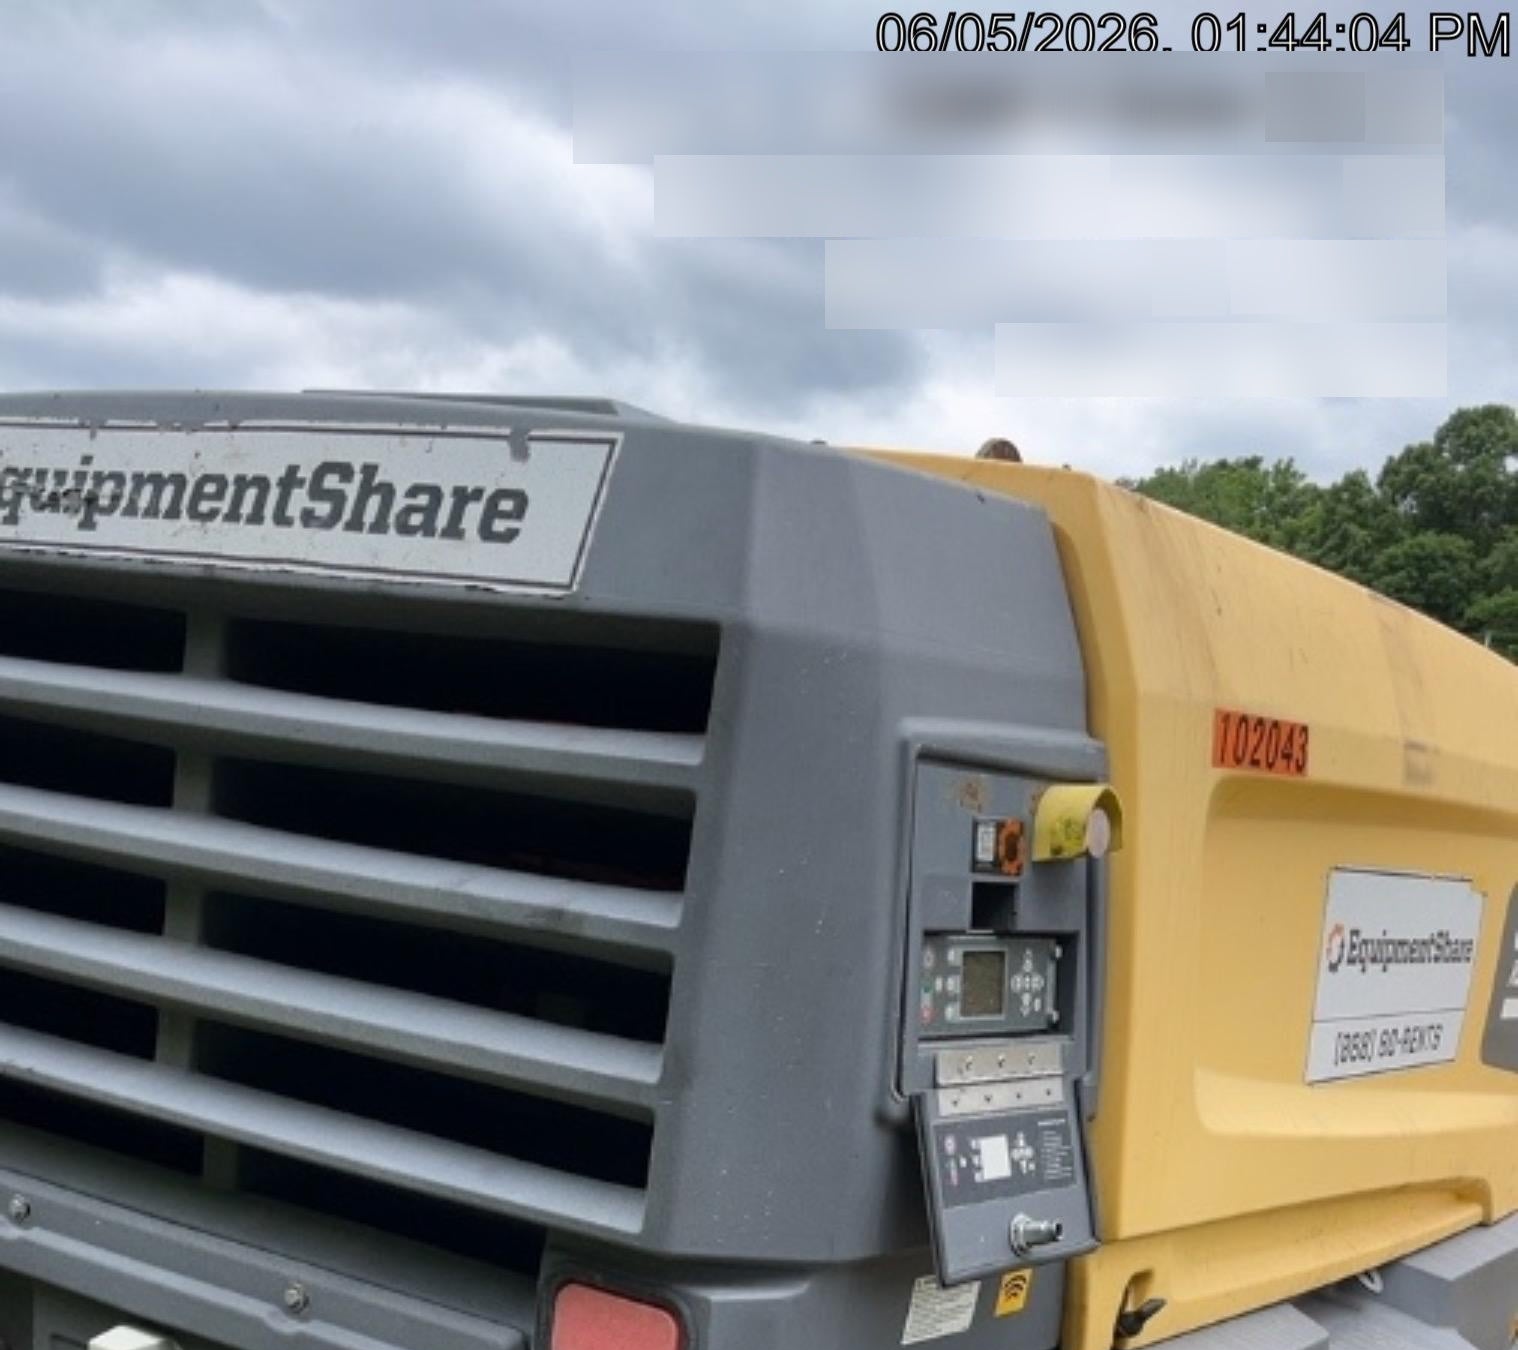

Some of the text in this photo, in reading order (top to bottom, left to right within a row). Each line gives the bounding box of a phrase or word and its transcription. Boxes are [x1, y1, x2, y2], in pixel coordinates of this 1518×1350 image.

[0, 455, 529, 543] quipmentShare
[1220, 712, 1309, 774] 102043
[1347, 929, 1474, 974] EquipmentShare
